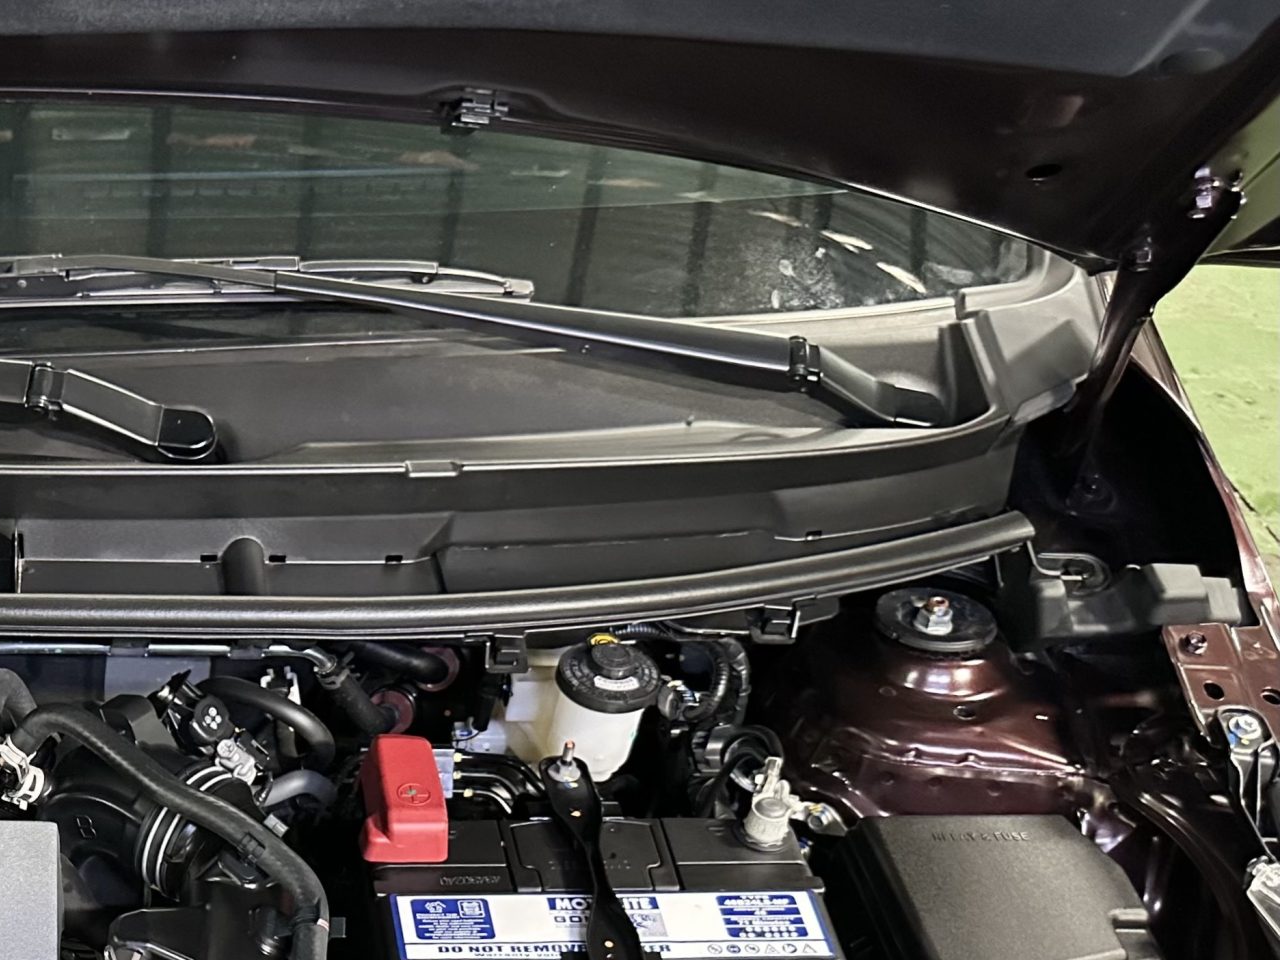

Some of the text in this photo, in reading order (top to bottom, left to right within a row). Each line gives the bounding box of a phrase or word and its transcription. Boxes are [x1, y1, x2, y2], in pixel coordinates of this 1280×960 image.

[992, 831, 1030, 842] FUSE
[437, 943, 587, 953] DO NOT REMOVE
